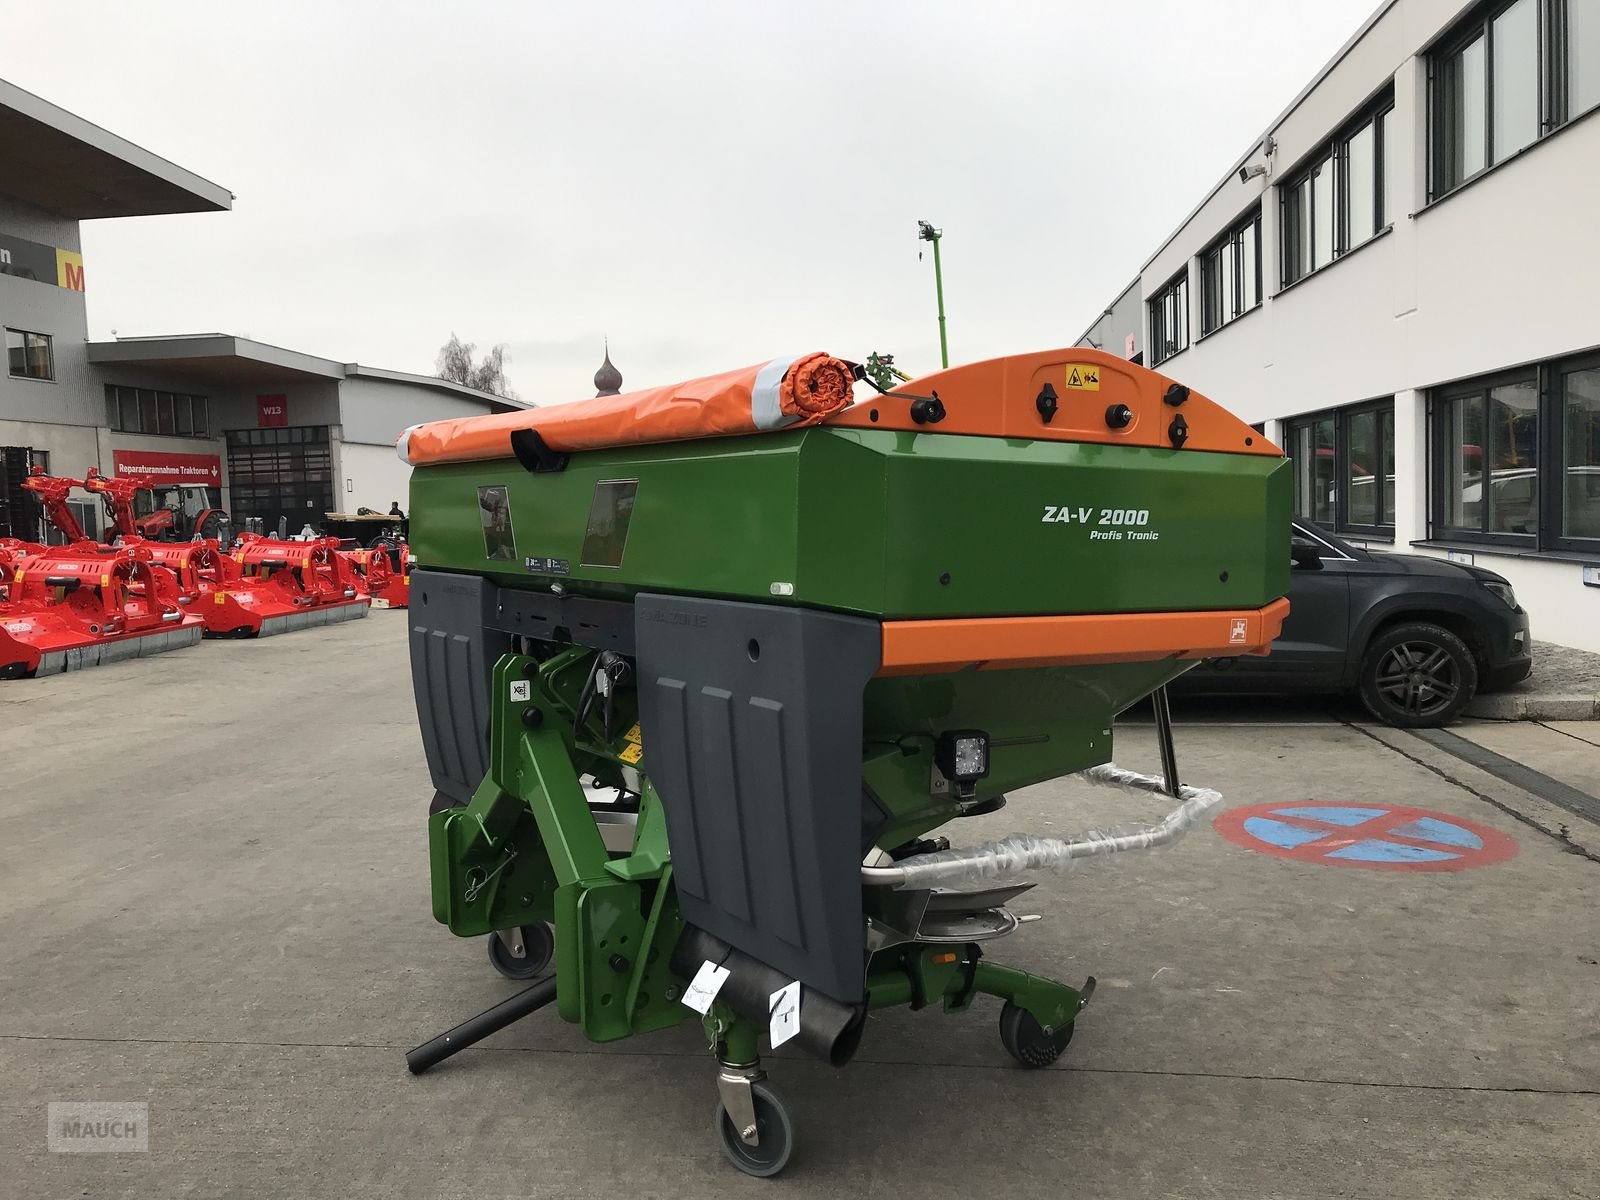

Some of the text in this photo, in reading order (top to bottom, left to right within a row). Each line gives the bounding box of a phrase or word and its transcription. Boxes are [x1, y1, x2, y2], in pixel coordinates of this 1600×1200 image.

[263, 406, 282, 415] W13
[119, 463, 209, 475] Reparaturannahme Traktoren
[1041, 505, 1149, 525] ZA-V 2000
[1089, 530, 1159, 540] Profis Tronic
